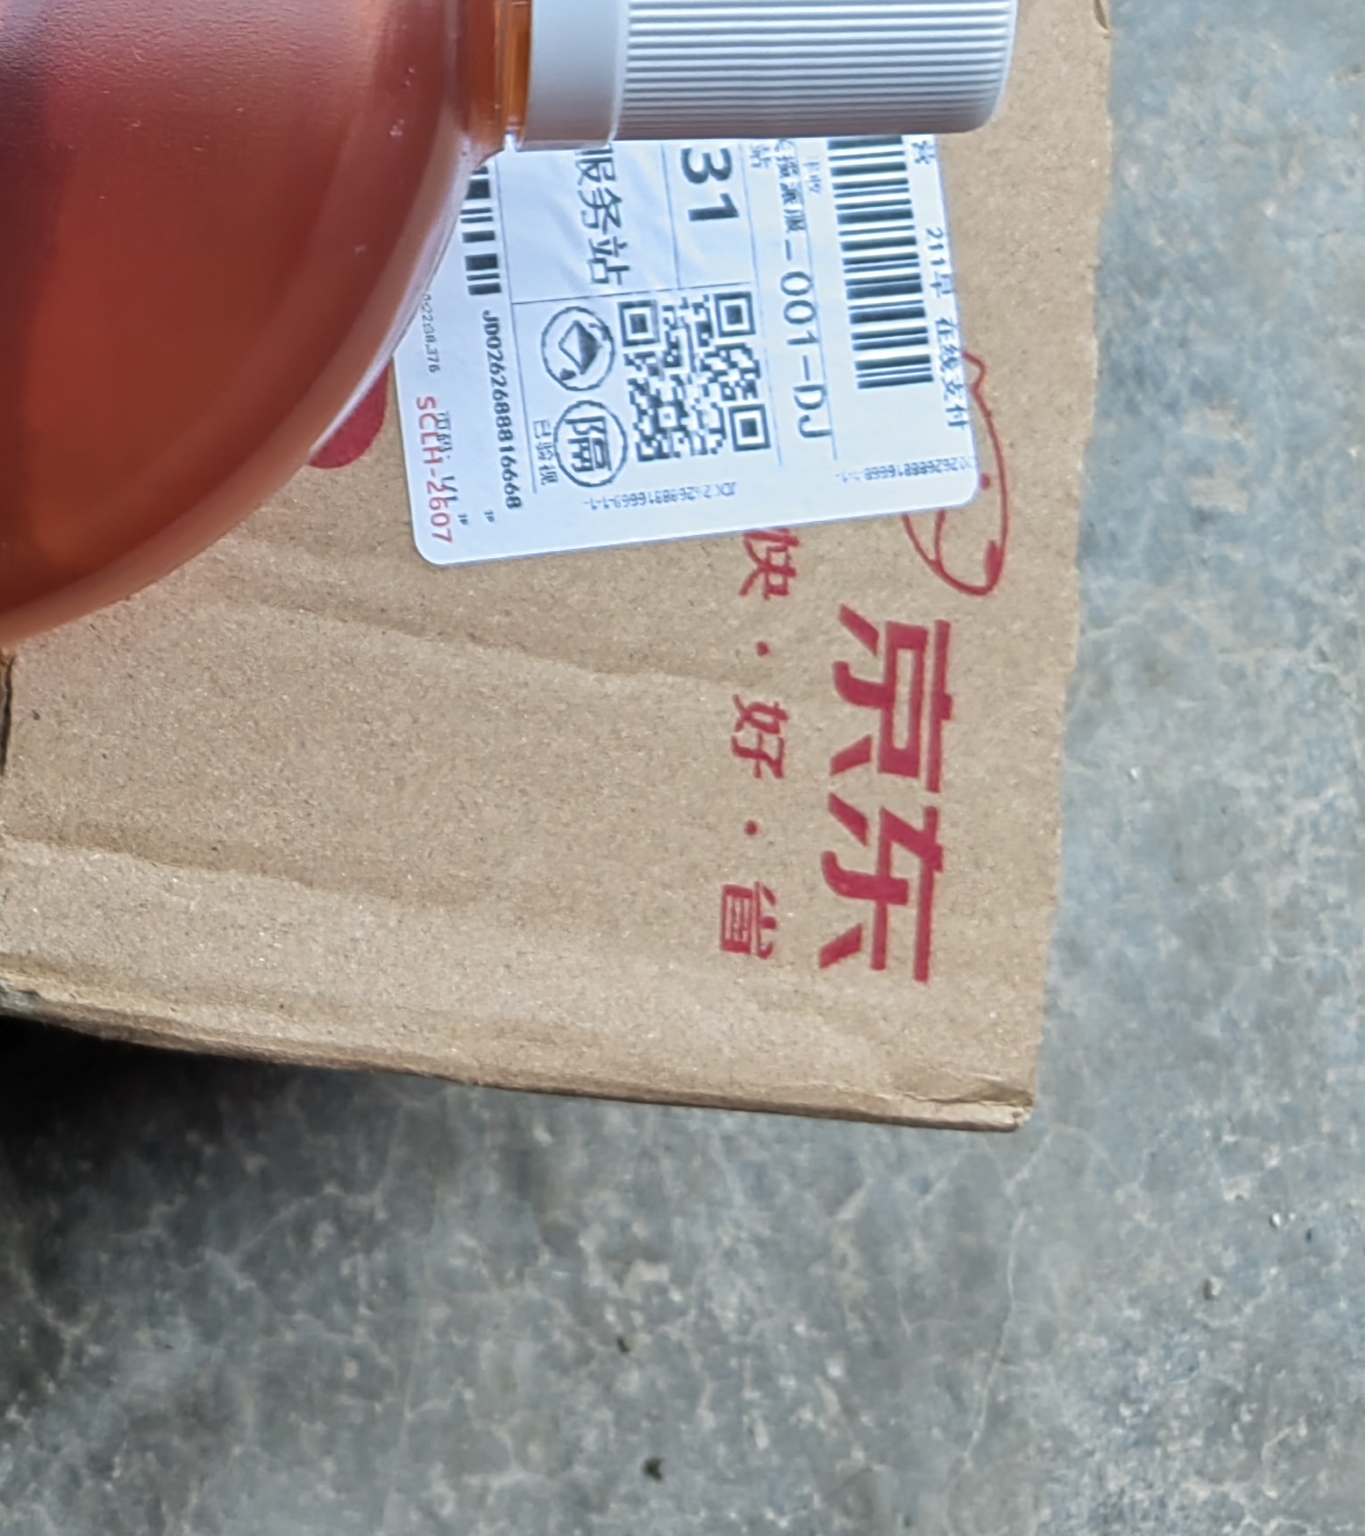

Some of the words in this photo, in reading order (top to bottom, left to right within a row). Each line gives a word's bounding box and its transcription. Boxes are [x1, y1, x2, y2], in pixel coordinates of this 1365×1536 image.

[574, 144, 630, 286] 服务站
[680, 148, 740, 222] 31
[482, 310, 522, 510] JD0262688816668
[935, 318, 969, 430] 在线支付
[416, 396, 453, 543] SCLH-2607
[533, 420, 558, 486] 已验视
[820, 604, 953, 982] 京东
